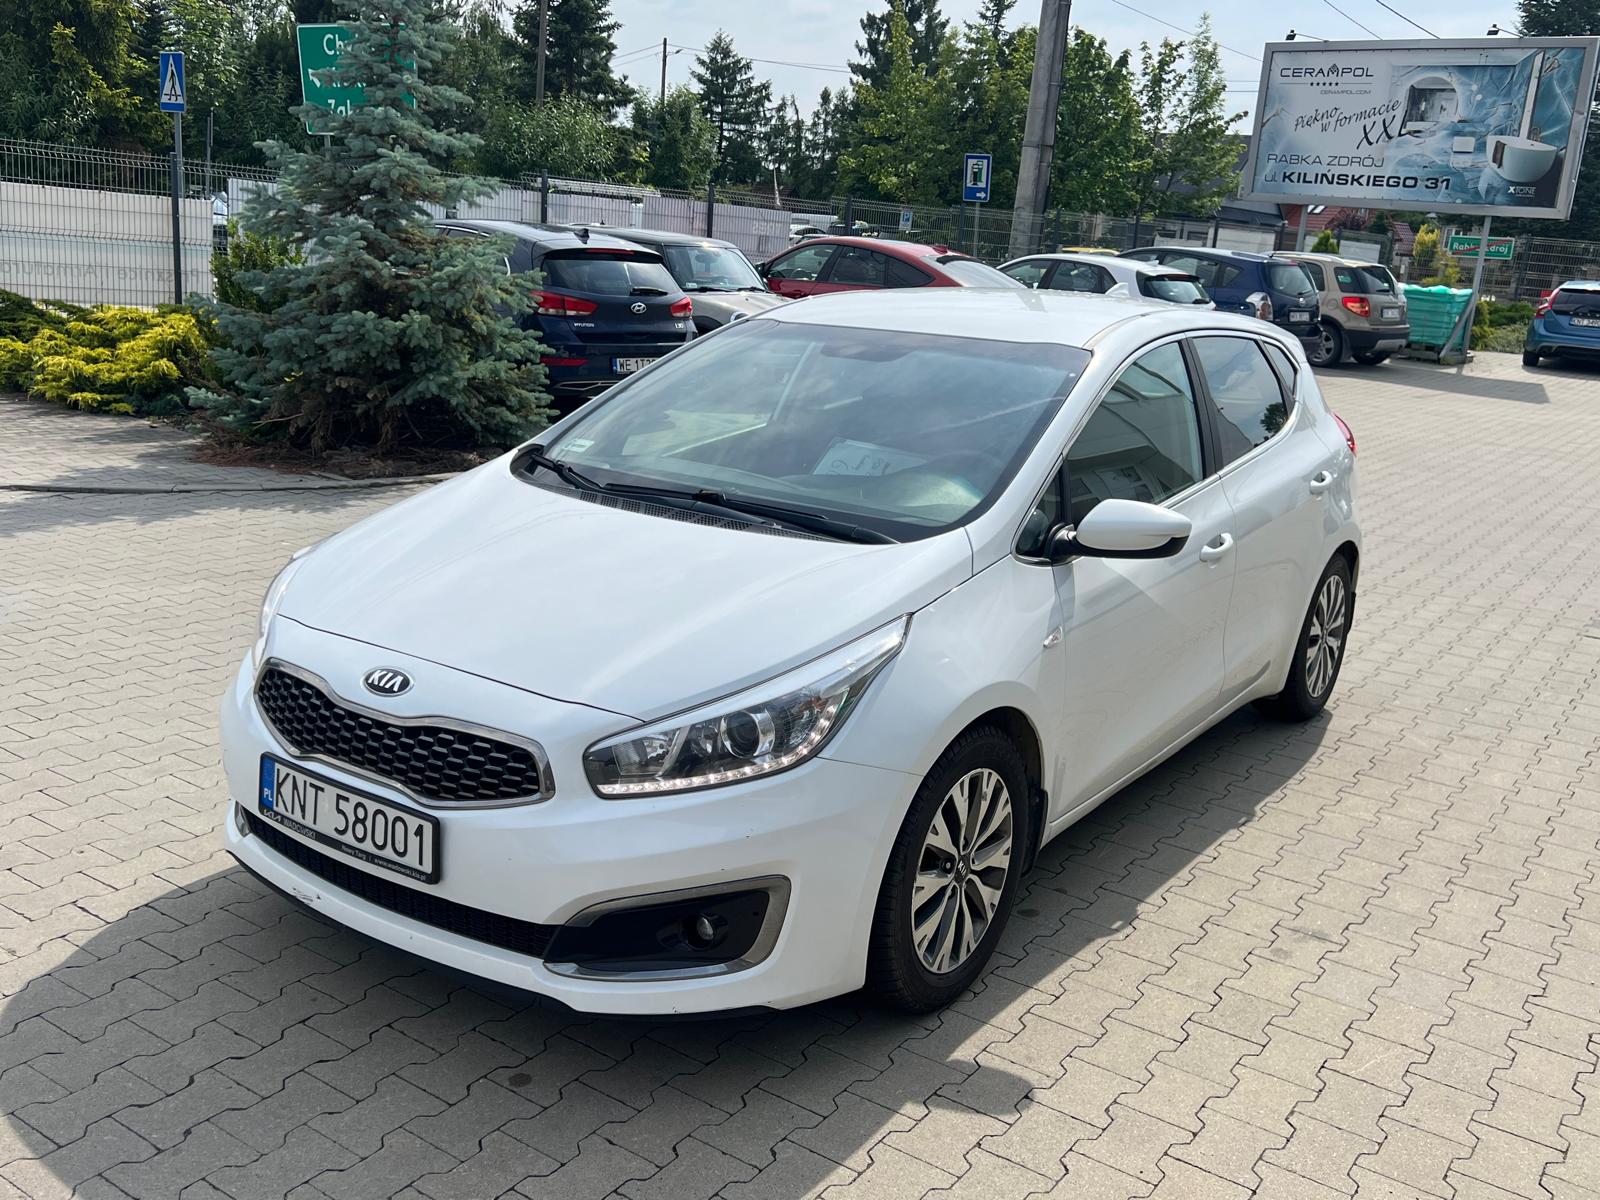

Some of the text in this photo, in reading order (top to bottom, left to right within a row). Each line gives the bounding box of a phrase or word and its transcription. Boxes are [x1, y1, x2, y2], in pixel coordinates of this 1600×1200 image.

[1280, 64, 1374, 78] CERAMPOL
[1333, 98, 1400, 132] formacie
[1356, 108, 1409, 150] XXL
[1267, 153, 1385, 168] RABKA ZDRÓJ
[1282, 168, 1418, 188] KILIŃSKIEGO
[1425, 178, 1450, 190] 31
[619, 359, 631, 370] WE
[367, 669, 404, 692] KIA
[263, 787, 273, 802] PL
[275, 767, 425, 867] KNT 58001
